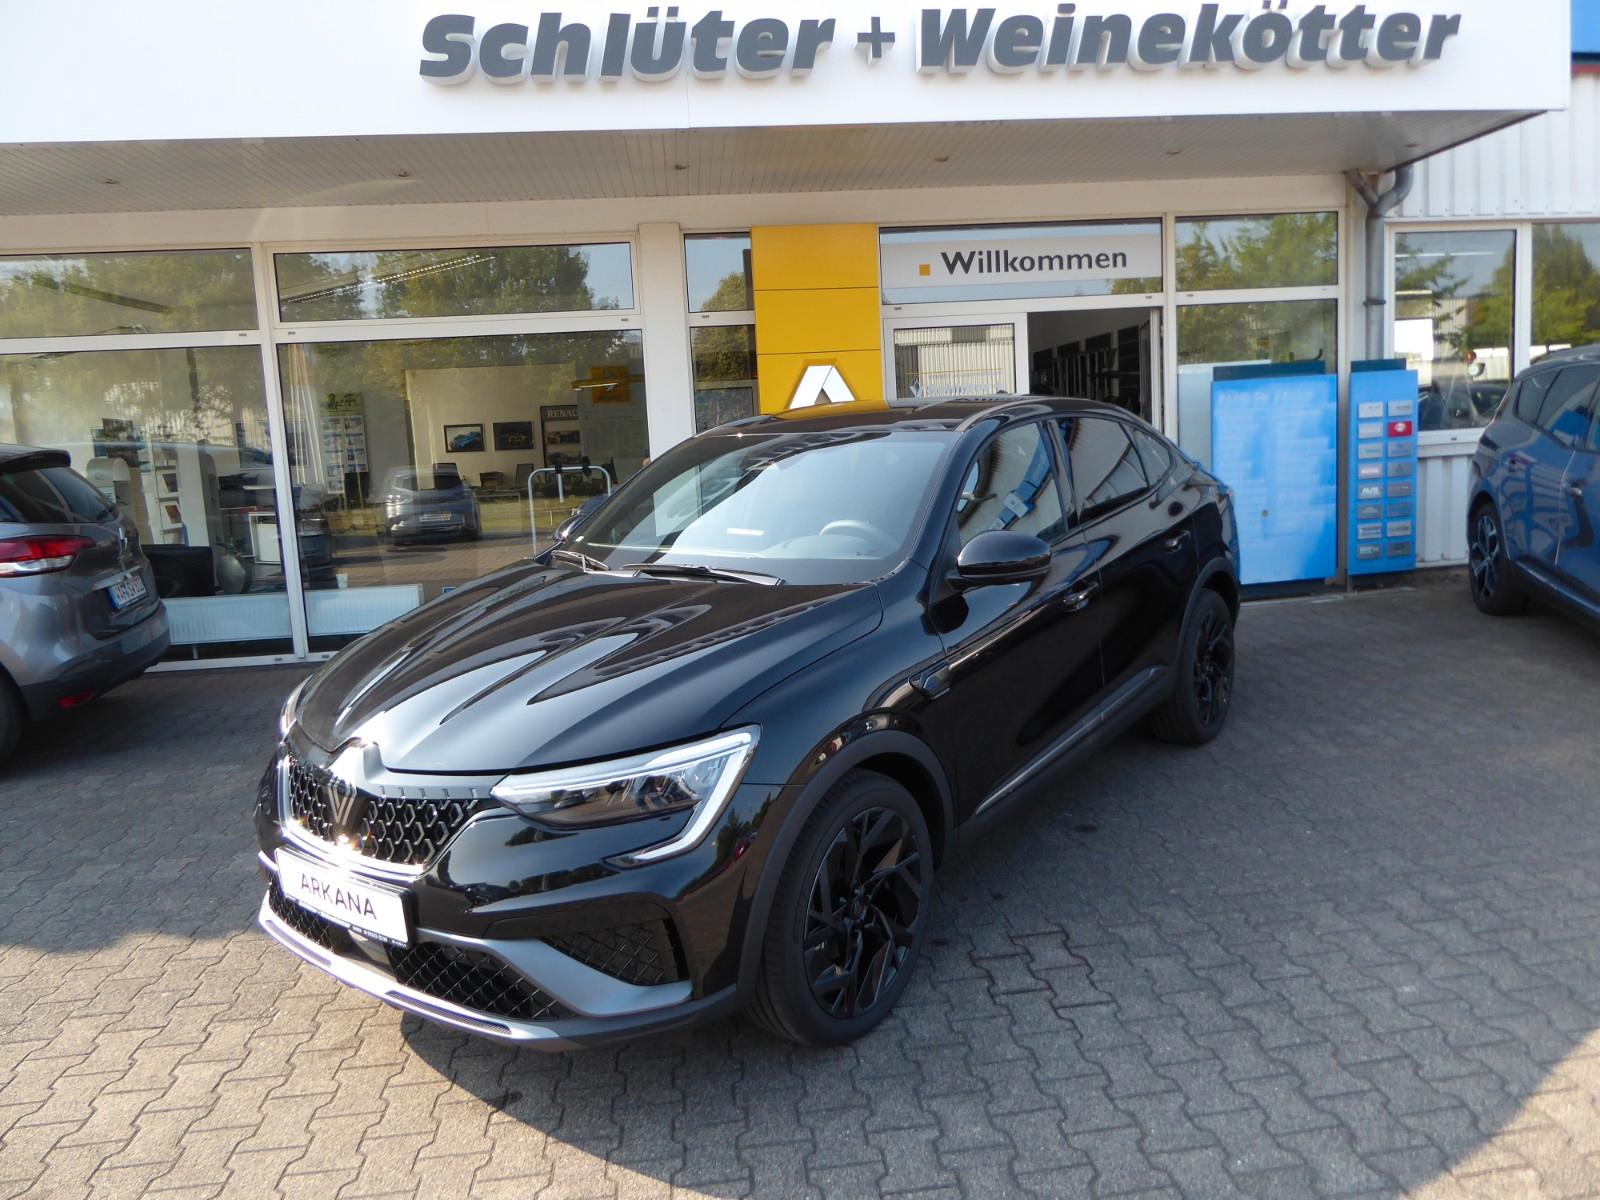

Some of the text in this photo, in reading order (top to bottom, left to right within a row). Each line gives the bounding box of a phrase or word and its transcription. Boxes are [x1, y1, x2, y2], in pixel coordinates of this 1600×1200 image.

[419, 0, 1462, 81] Schlüter + Weinekötter
[940, 249, 1128, 275] Willkommen
[301, 873, 377, 920] ARKANA
